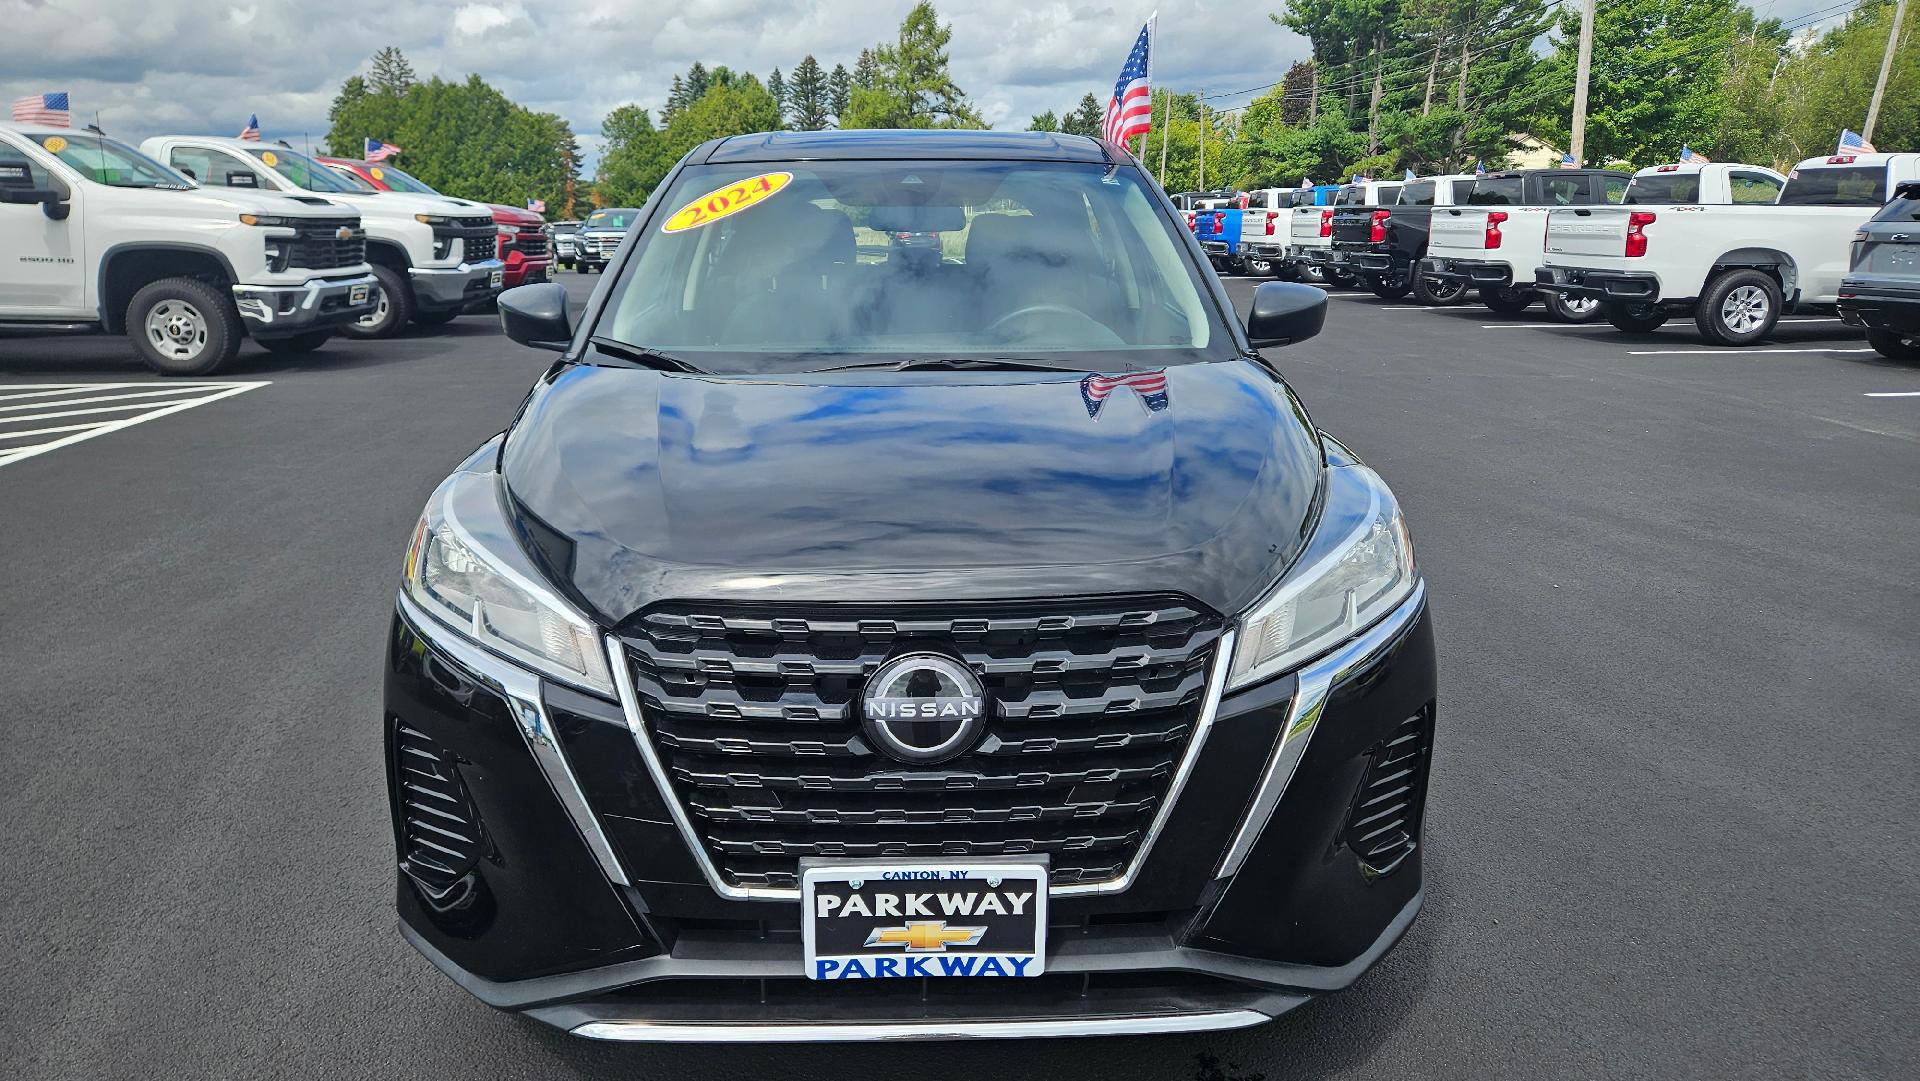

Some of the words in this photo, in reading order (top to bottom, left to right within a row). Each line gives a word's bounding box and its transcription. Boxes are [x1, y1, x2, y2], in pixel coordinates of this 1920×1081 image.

[683, 176, 773, 226] 2024
[869, 700, 979, 718] NISSAN
[882, 871, 945, 881] CANTON,
[949, 870, 969, 880] NY
[817, 892, 1033, 918] PARKWAY
[815, 956, 1034, 980] PARKWAY
